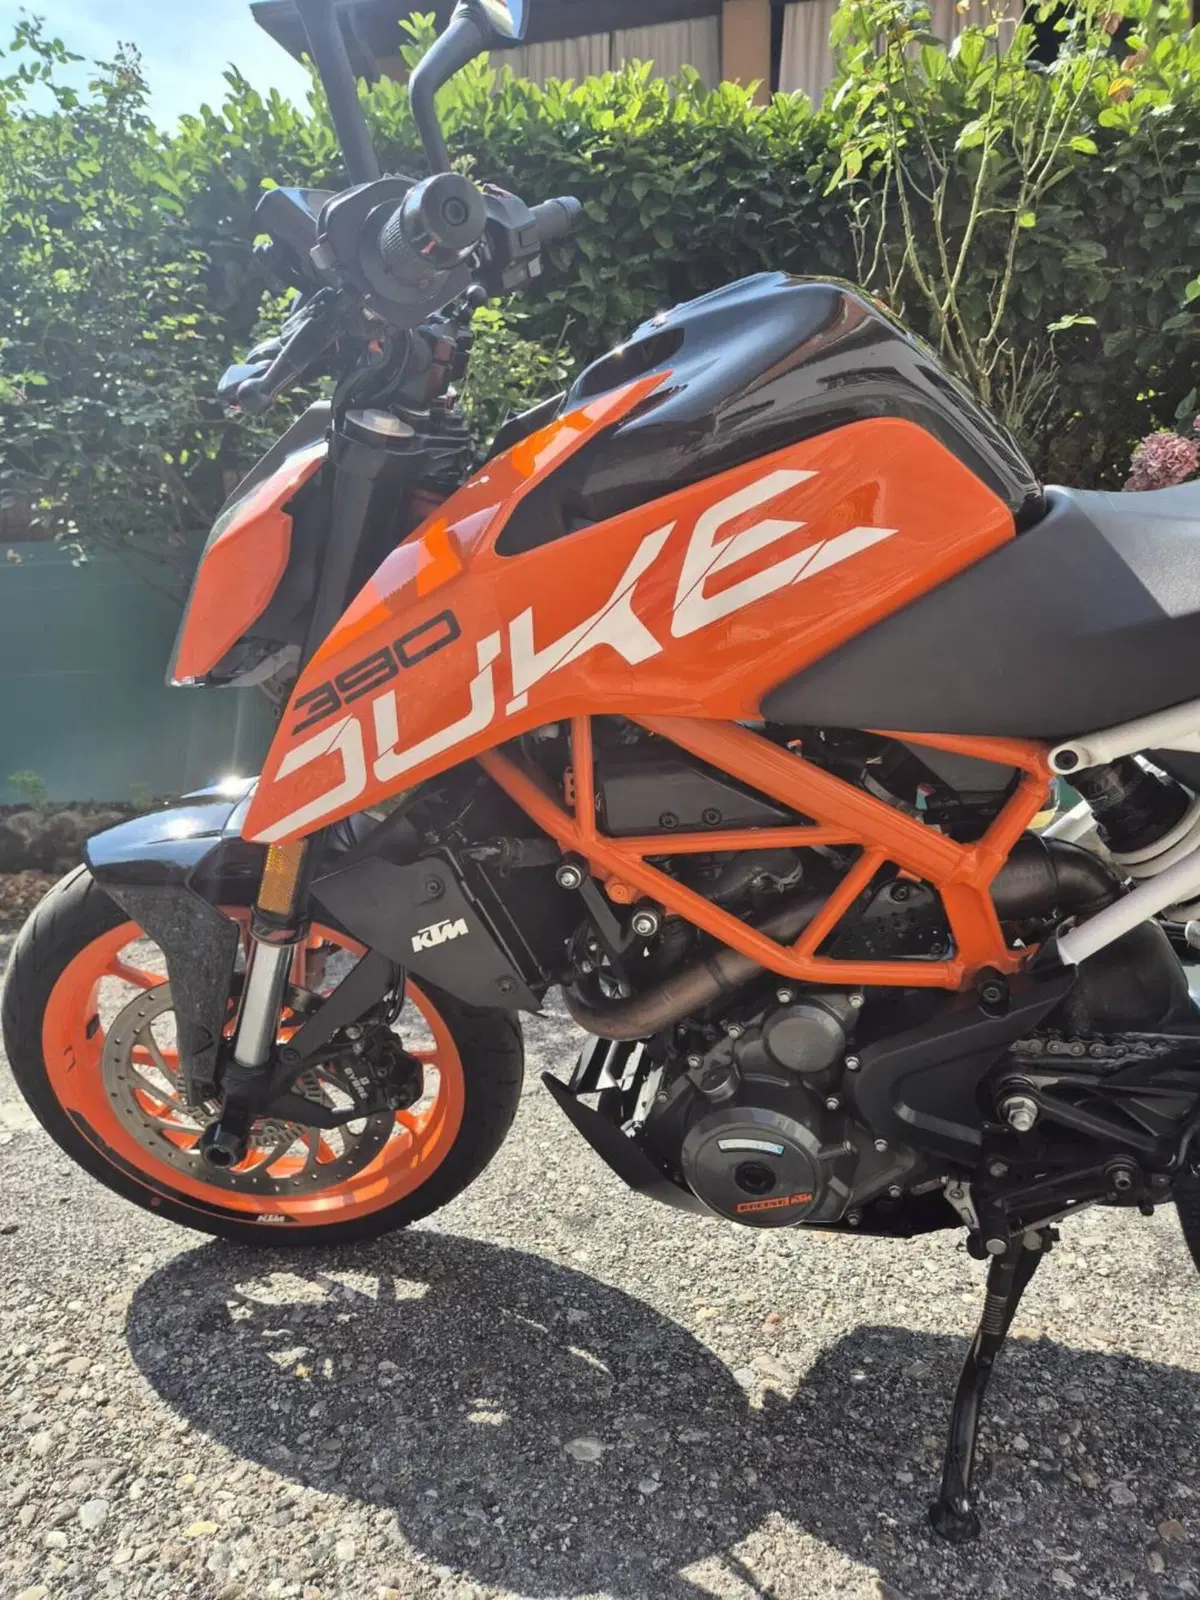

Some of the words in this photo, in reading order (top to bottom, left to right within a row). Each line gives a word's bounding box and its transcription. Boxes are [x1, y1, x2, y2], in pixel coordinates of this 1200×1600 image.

[252, 469, 898, 842] DUKE
[293, 608, 461, 735] 390
[411, 918, 469, 953] KTM
